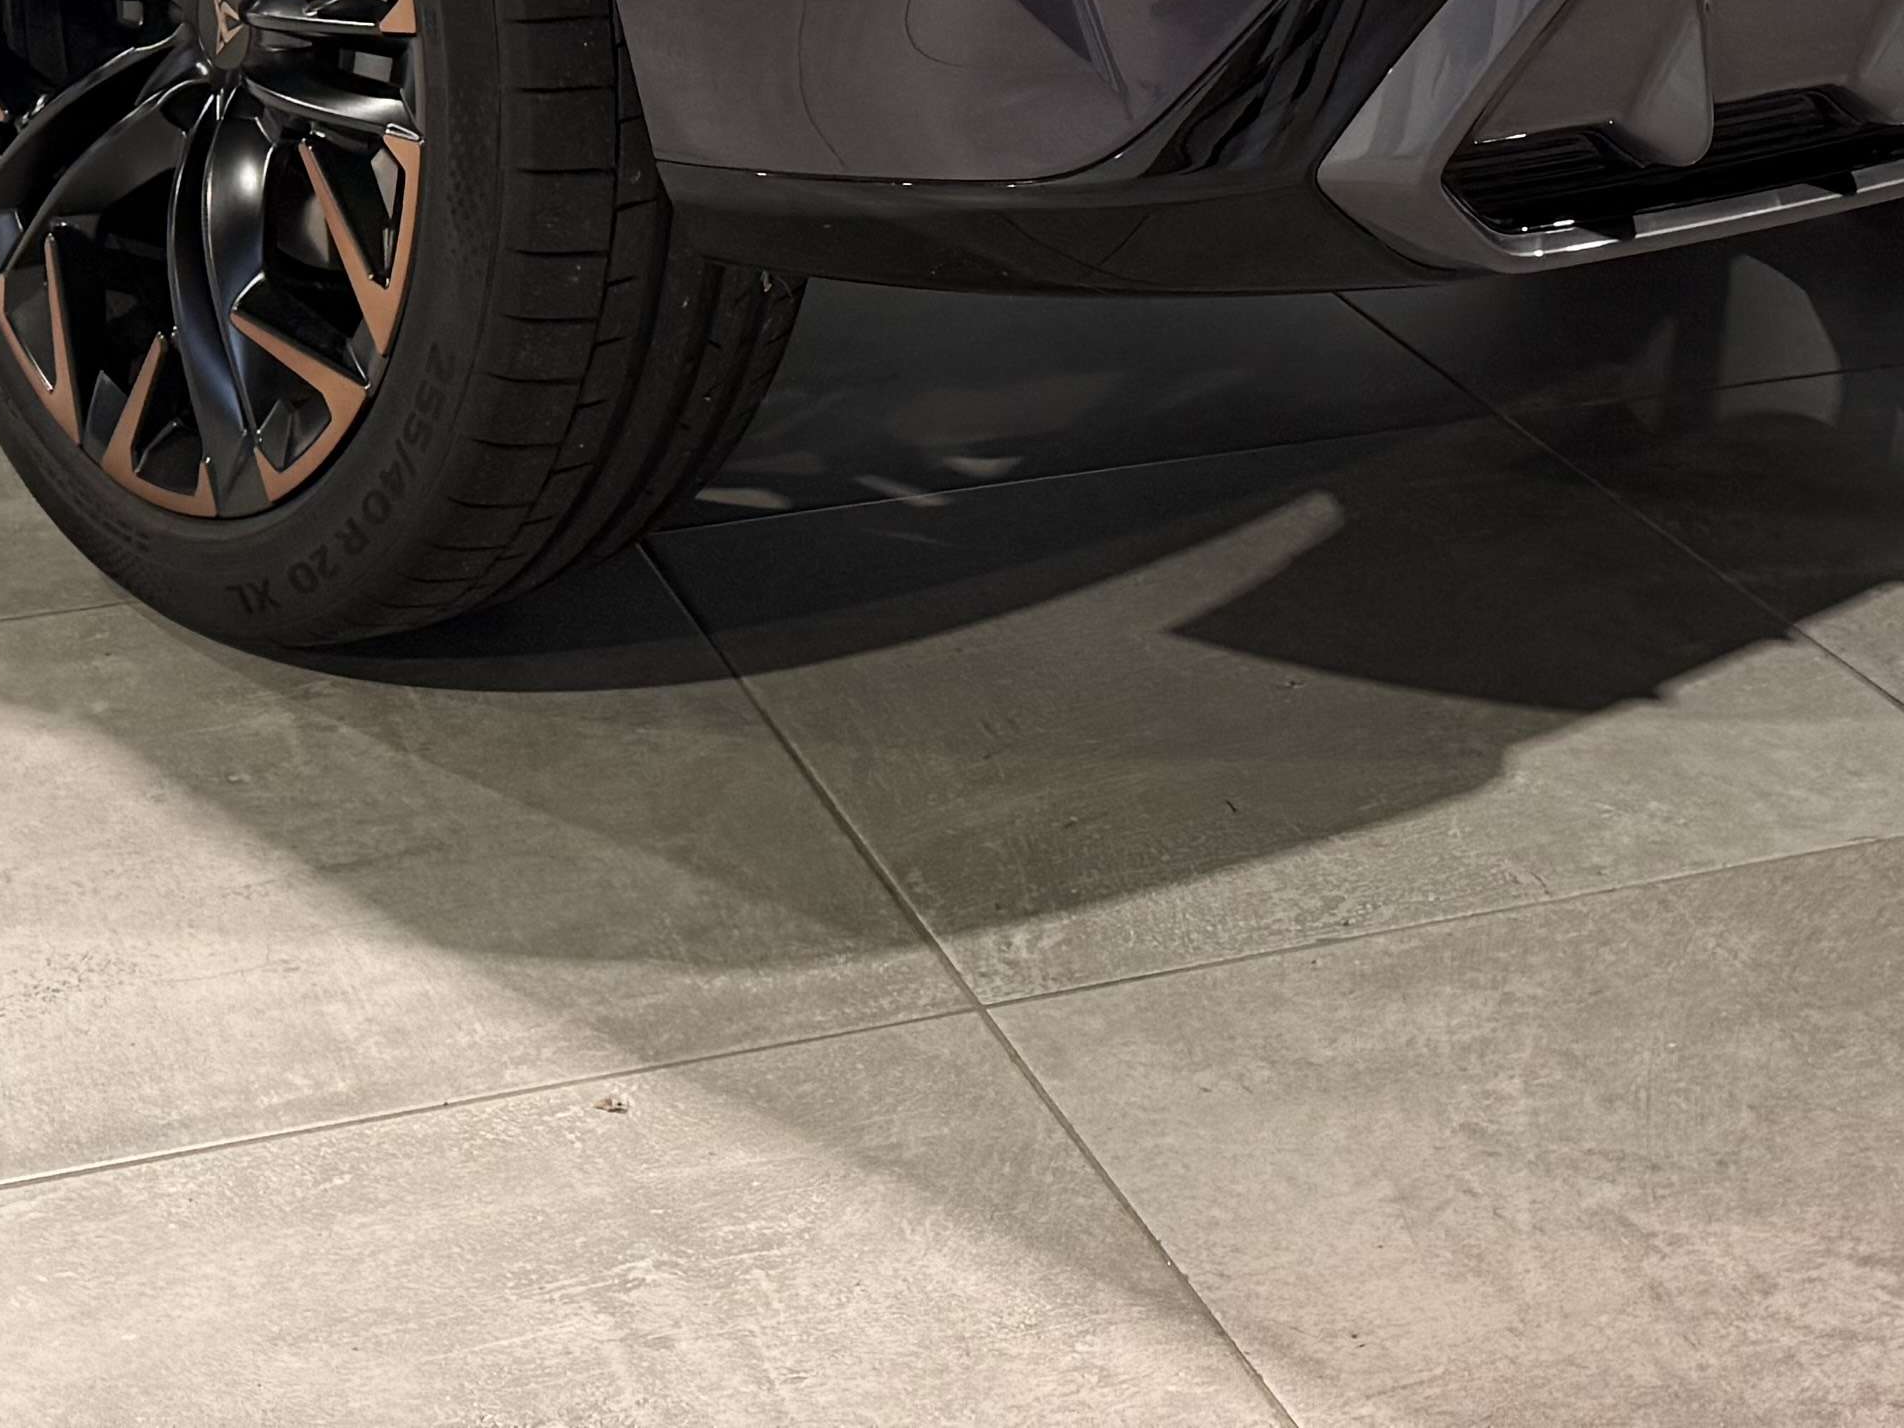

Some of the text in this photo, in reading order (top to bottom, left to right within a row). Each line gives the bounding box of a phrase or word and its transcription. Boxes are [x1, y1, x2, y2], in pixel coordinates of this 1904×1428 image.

[222, 340, 459, 617] 255/40 R 20 XL
